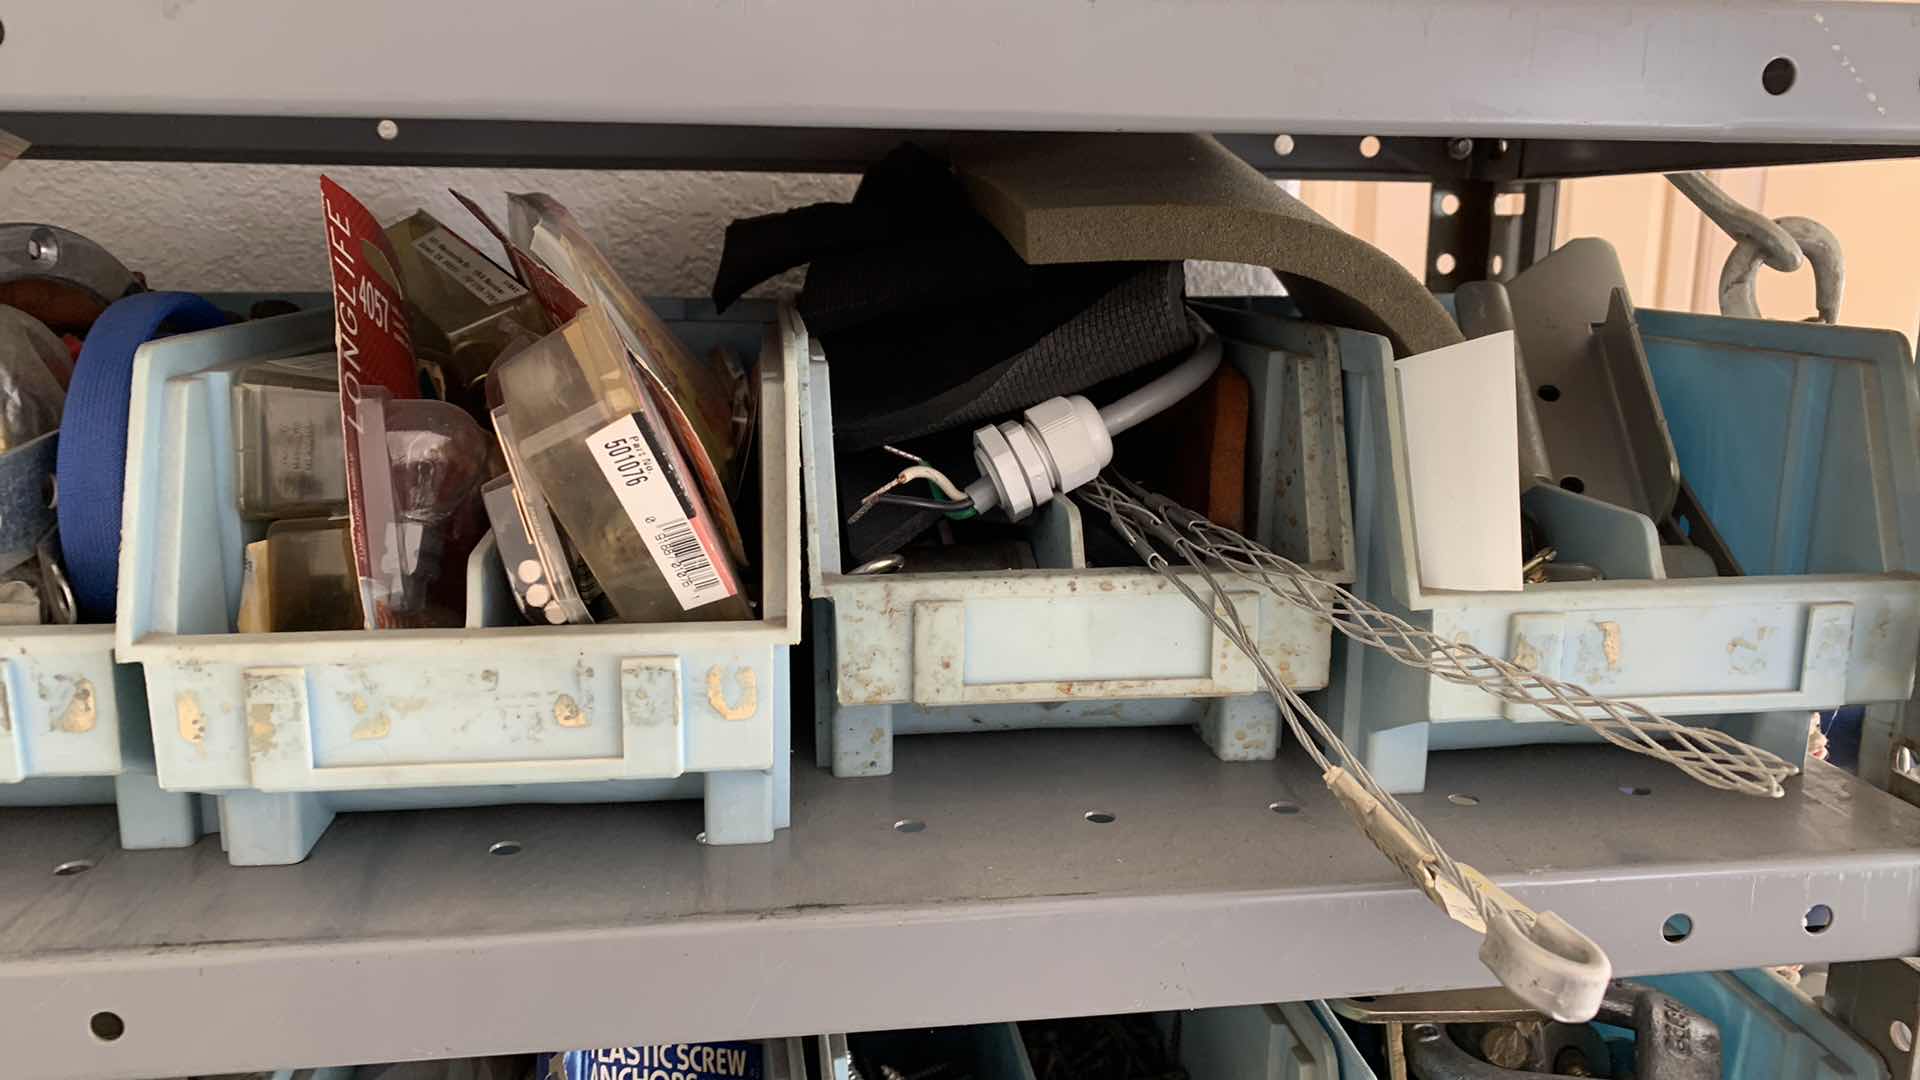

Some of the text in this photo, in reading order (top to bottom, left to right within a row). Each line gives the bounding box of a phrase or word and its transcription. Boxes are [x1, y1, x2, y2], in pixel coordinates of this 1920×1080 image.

[326, 198, 364, 433] LONGLIFE
[359, 275, 388, 332] 4057
[604, 438, 649, 487] 501076
[676, 1044, 747, 1077] SCREW
